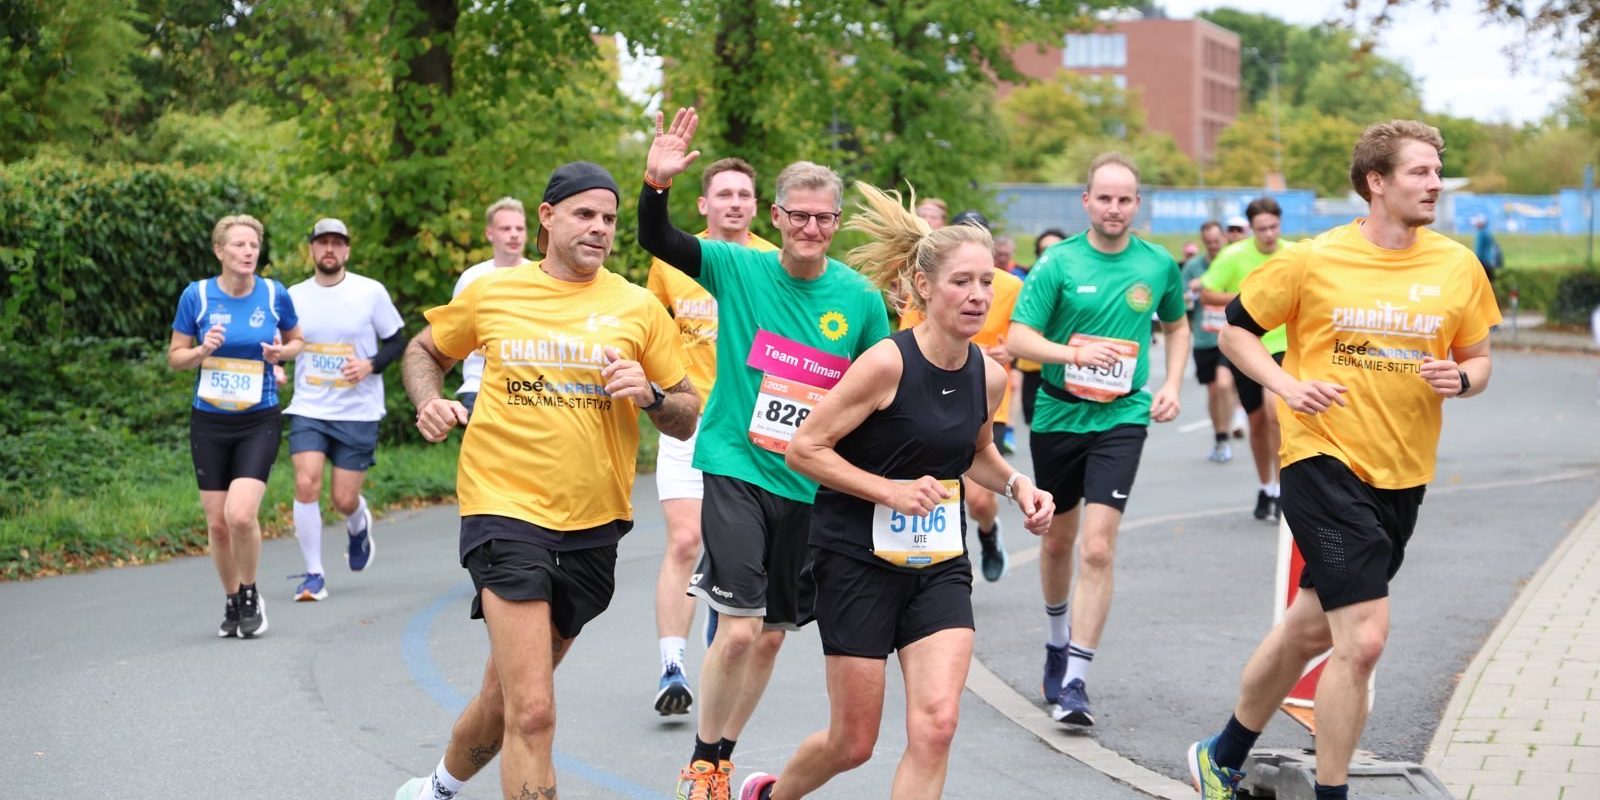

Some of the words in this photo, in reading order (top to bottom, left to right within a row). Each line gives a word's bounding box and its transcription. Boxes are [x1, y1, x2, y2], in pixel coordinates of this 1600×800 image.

[764, 344, 799, 367] Team
[803, 358, 841, 379] Tilman
[1332, 355, 1421, 374] LEUKÄMIE-STIFTU
[211, 371, 251, 390] 5538
[506, 375, 544, 394] josé
[766, 400, 811, 428] 828
[890, 506, 946, 533] 5106
[914, 535, 927, 544] UTE
